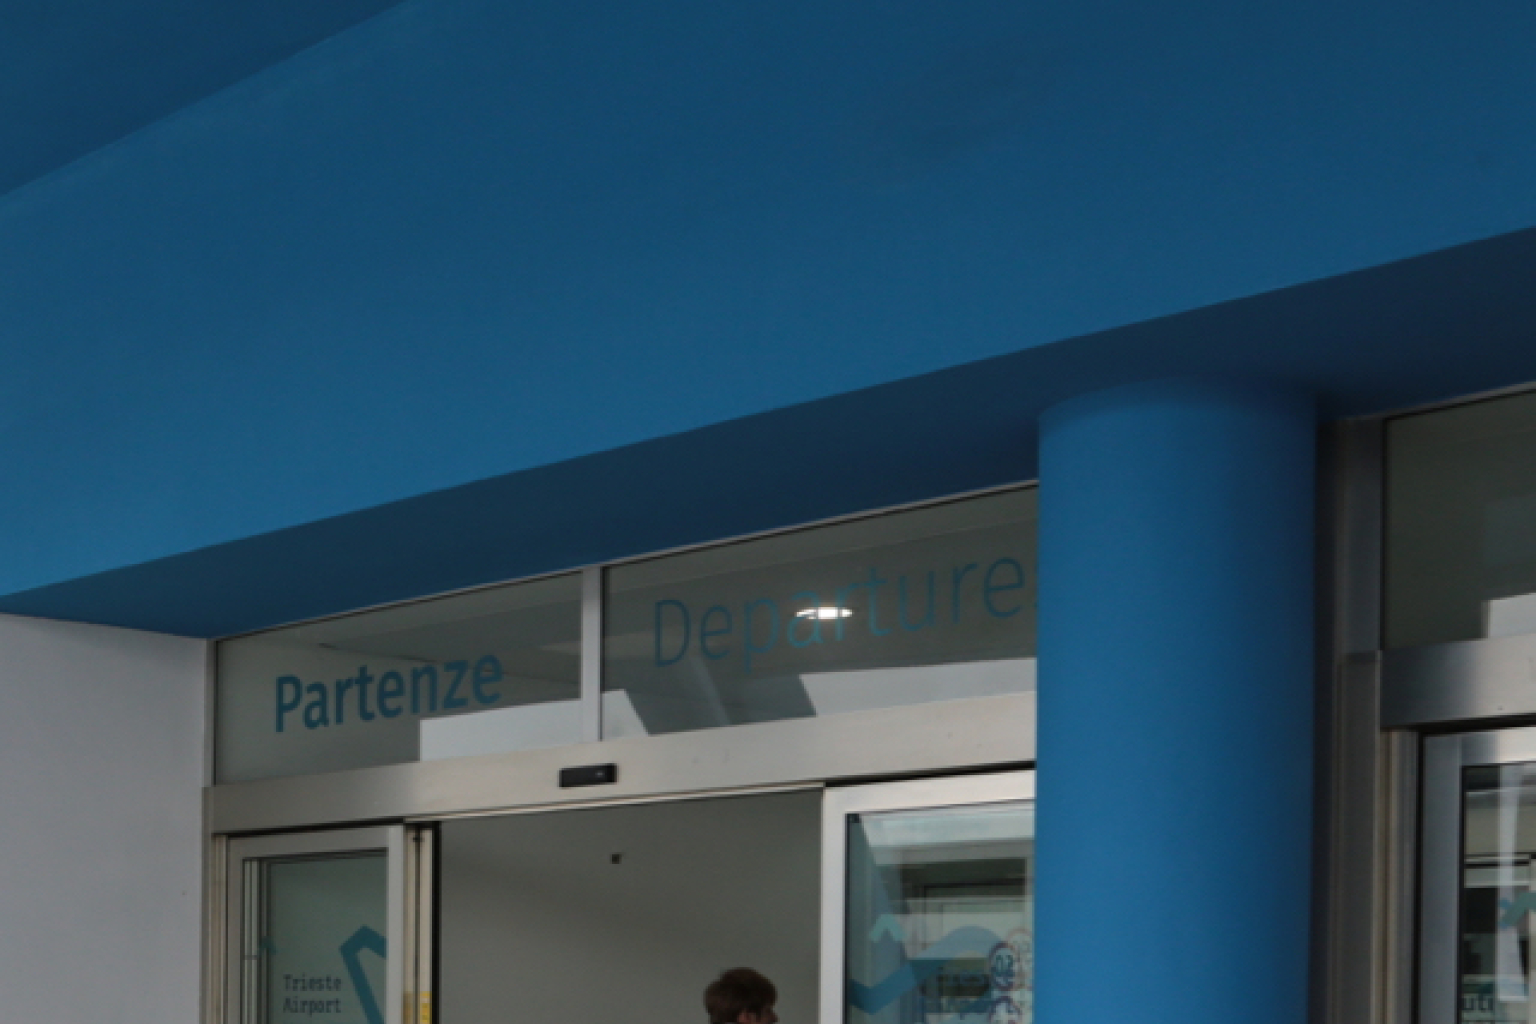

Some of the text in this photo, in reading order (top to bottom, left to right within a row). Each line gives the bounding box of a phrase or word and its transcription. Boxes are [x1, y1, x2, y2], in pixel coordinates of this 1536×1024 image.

[653, 556, 1037, 672] Departure
[275, 654, 504, 733] Partenze
[282, 973, 342, 992] Trieste
[282, 996, 342, 1016] Airport
